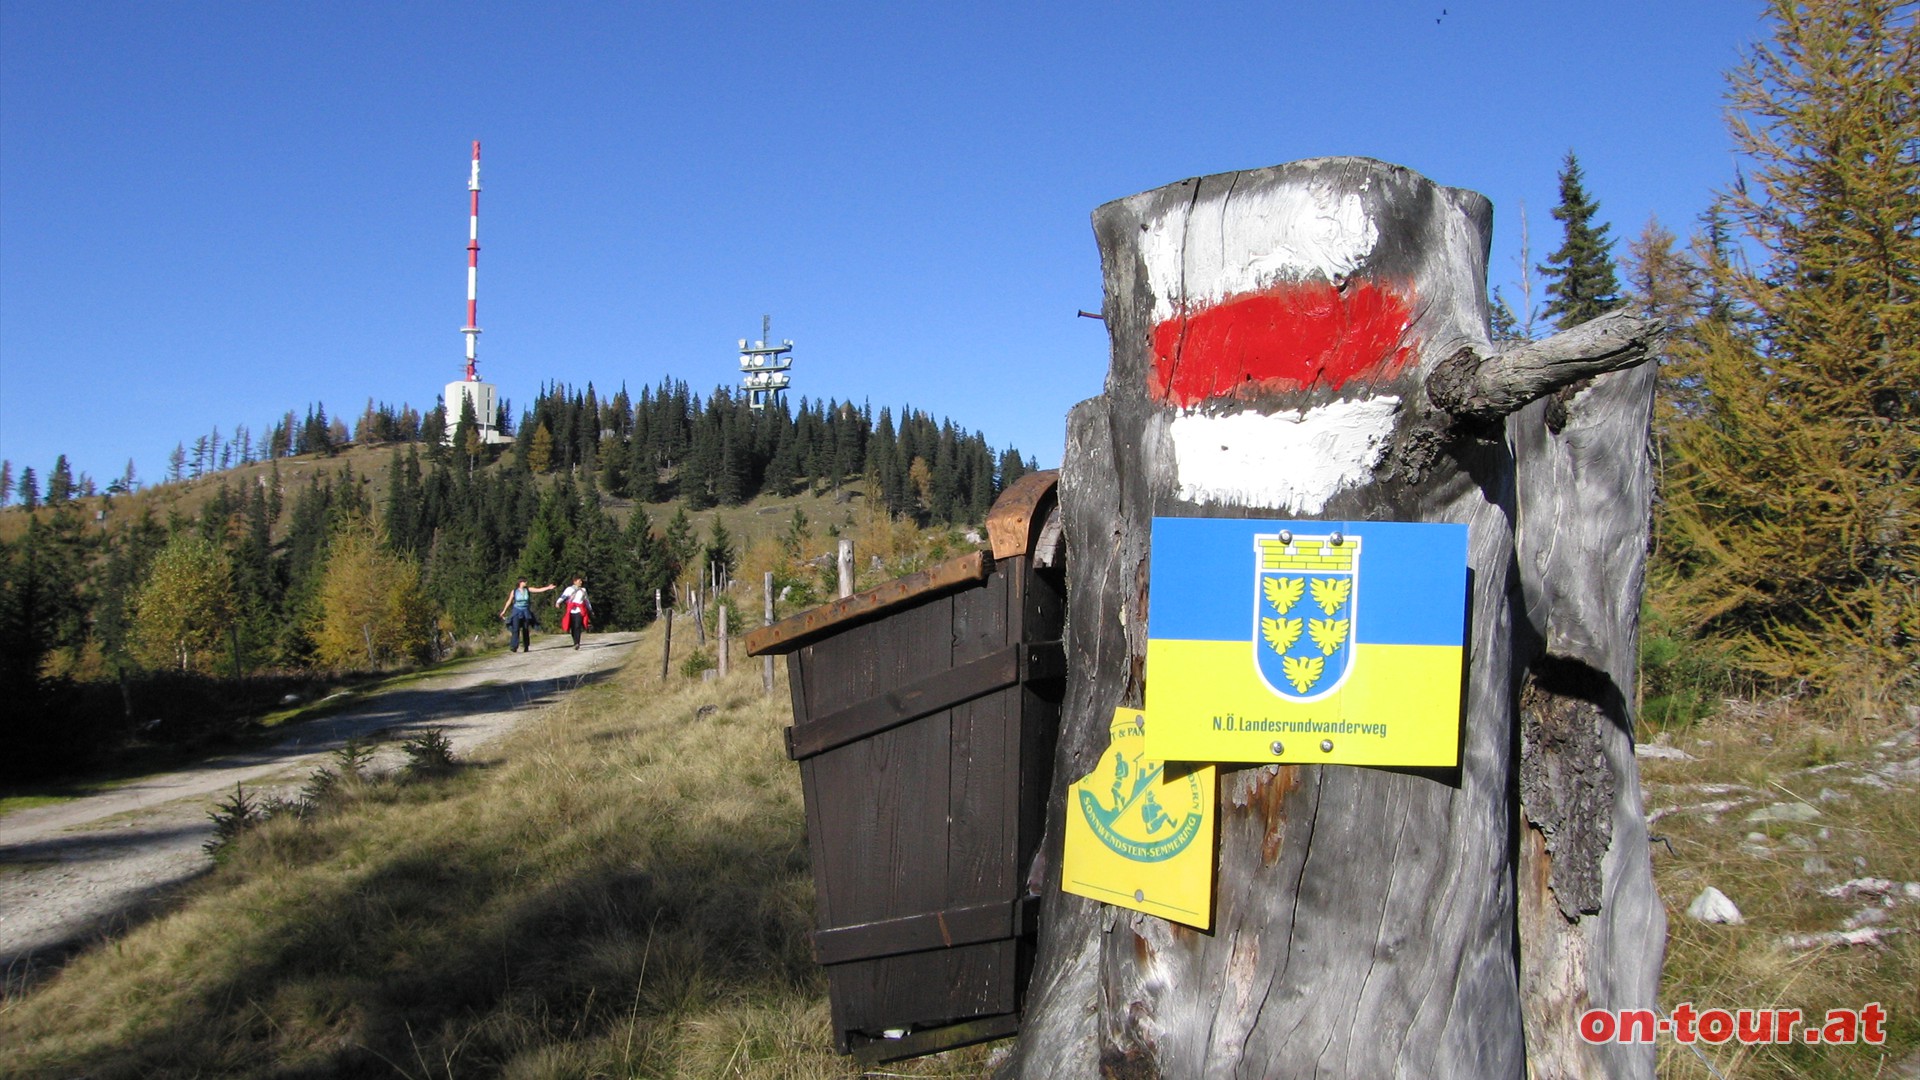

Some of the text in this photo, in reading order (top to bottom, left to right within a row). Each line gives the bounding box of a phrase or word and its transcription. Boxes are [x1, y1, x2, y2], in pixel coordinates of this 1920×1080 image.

[1212, 713, 1387, 738] N.Ö. Landesrundwanderweg
[1127, 725, 1145, 736] PAN
[1187, 773, 1200, 810] DERN
